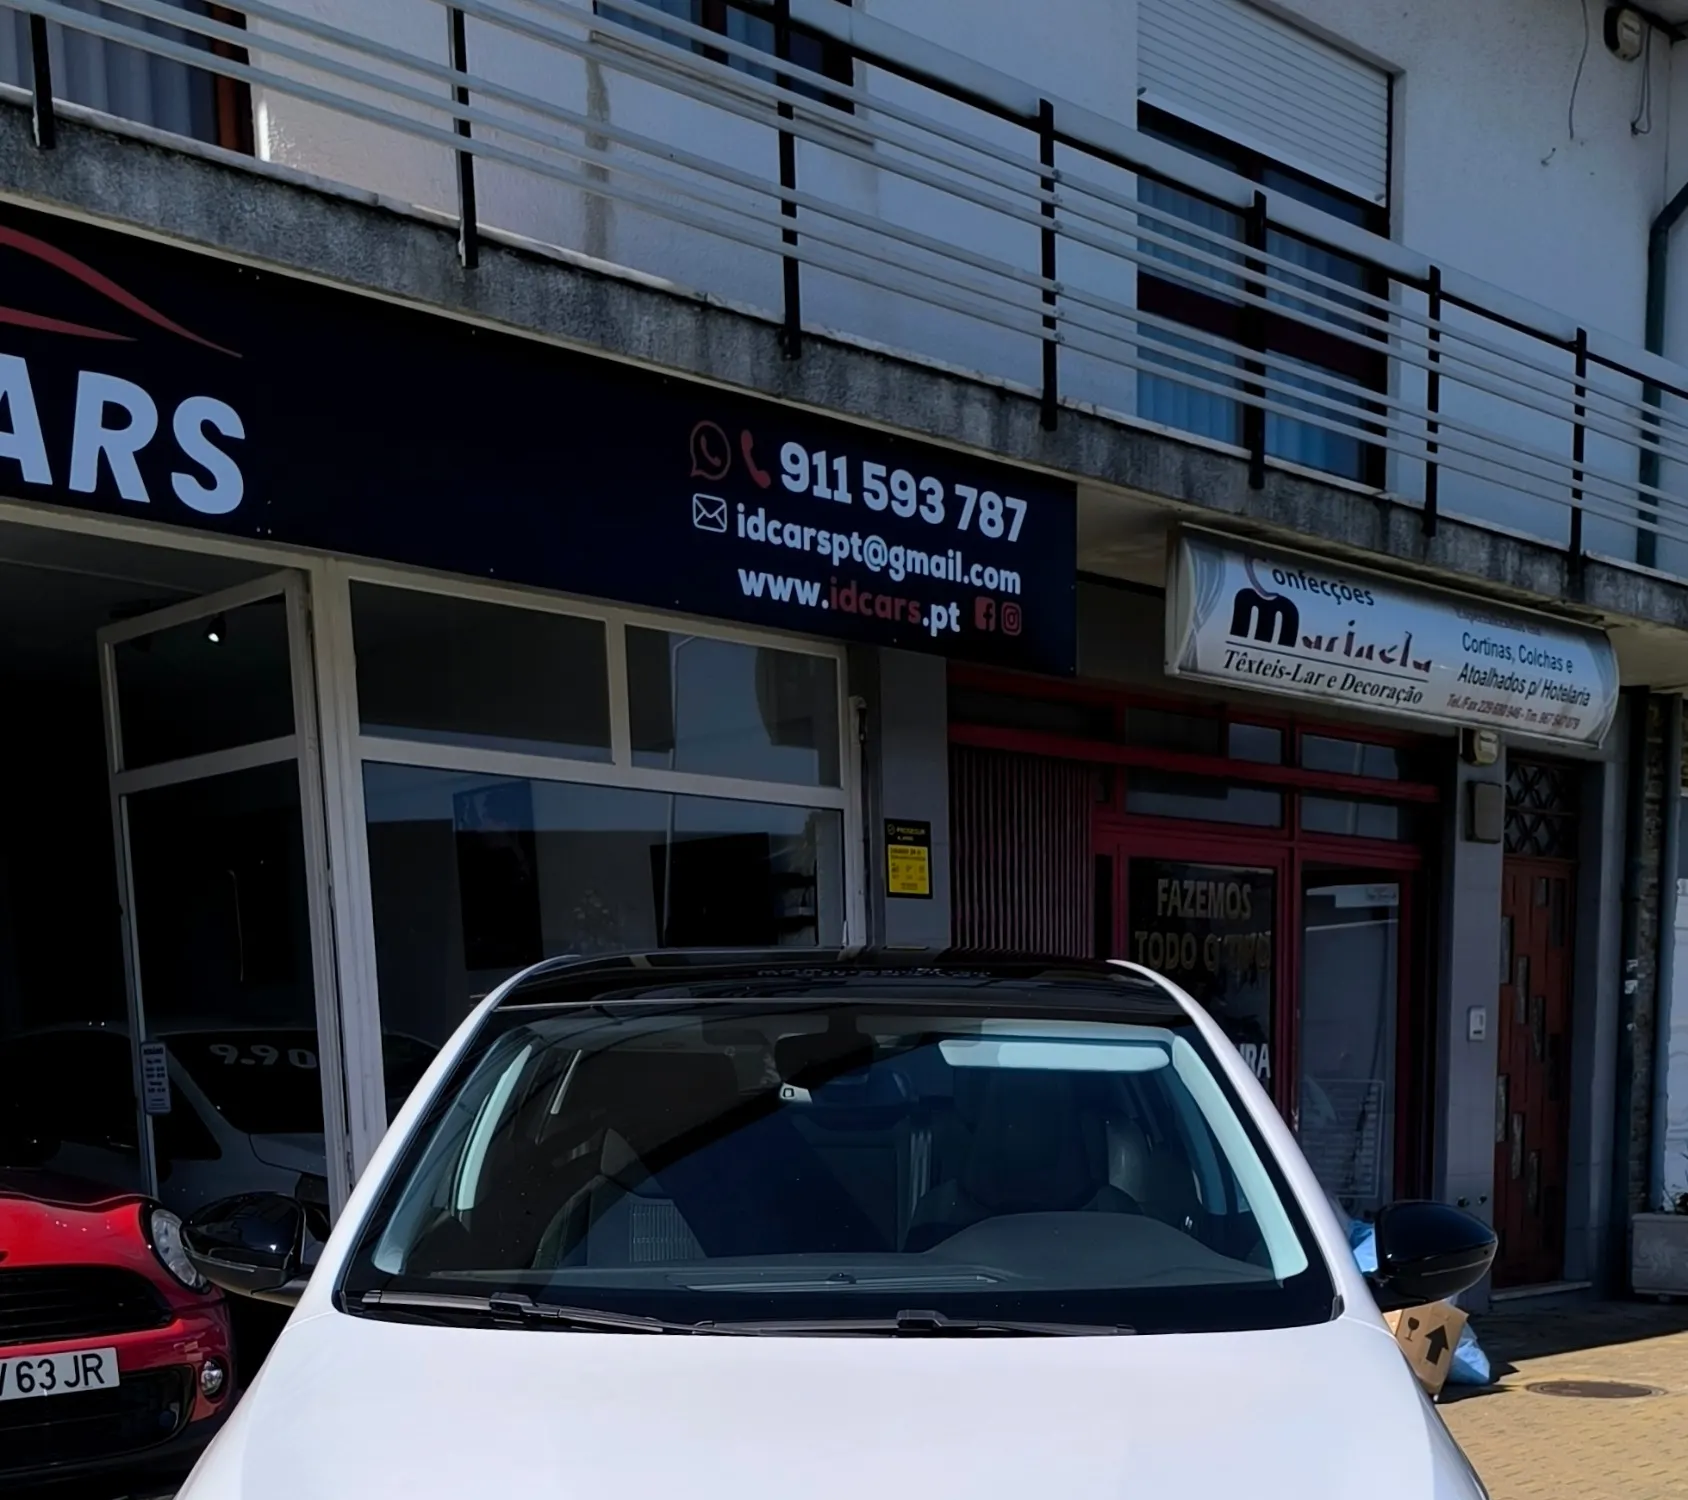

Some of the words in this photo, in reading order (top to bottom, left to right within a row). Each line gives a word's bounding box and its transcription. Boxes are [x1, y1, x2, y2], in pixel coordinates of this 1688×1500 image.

[780, 441, 852, 504] 911
[863, 461, 945, 525] 593
[955, 483, 1028, 542] 787
[737, 503, 1021, 595] idcarspt@gmail.com
[738, 568, 960, 637] www.idcars.pt
[1462, 632, 1515, 664] Cortinas,
[1518, 645, 1564, 672] Colchas
[1566, 660, 1574, 674] e
[1223, 648, 1326, 684] Têxteis-Lar
[1327, 674, 1338, 689] e
[1340, 673, 1424, 706] Decoração
[1457, 662, 1527, 694] Atoalhados
[1541, 679, 1591, 707] Hotelaria
[1157, 878, 1252, 920] FAZEMOS
[1135, 931, 1197, 970] TODO
[16, 1358, 56, 1393] 63
[64, 1353, 105, 1388] JR
